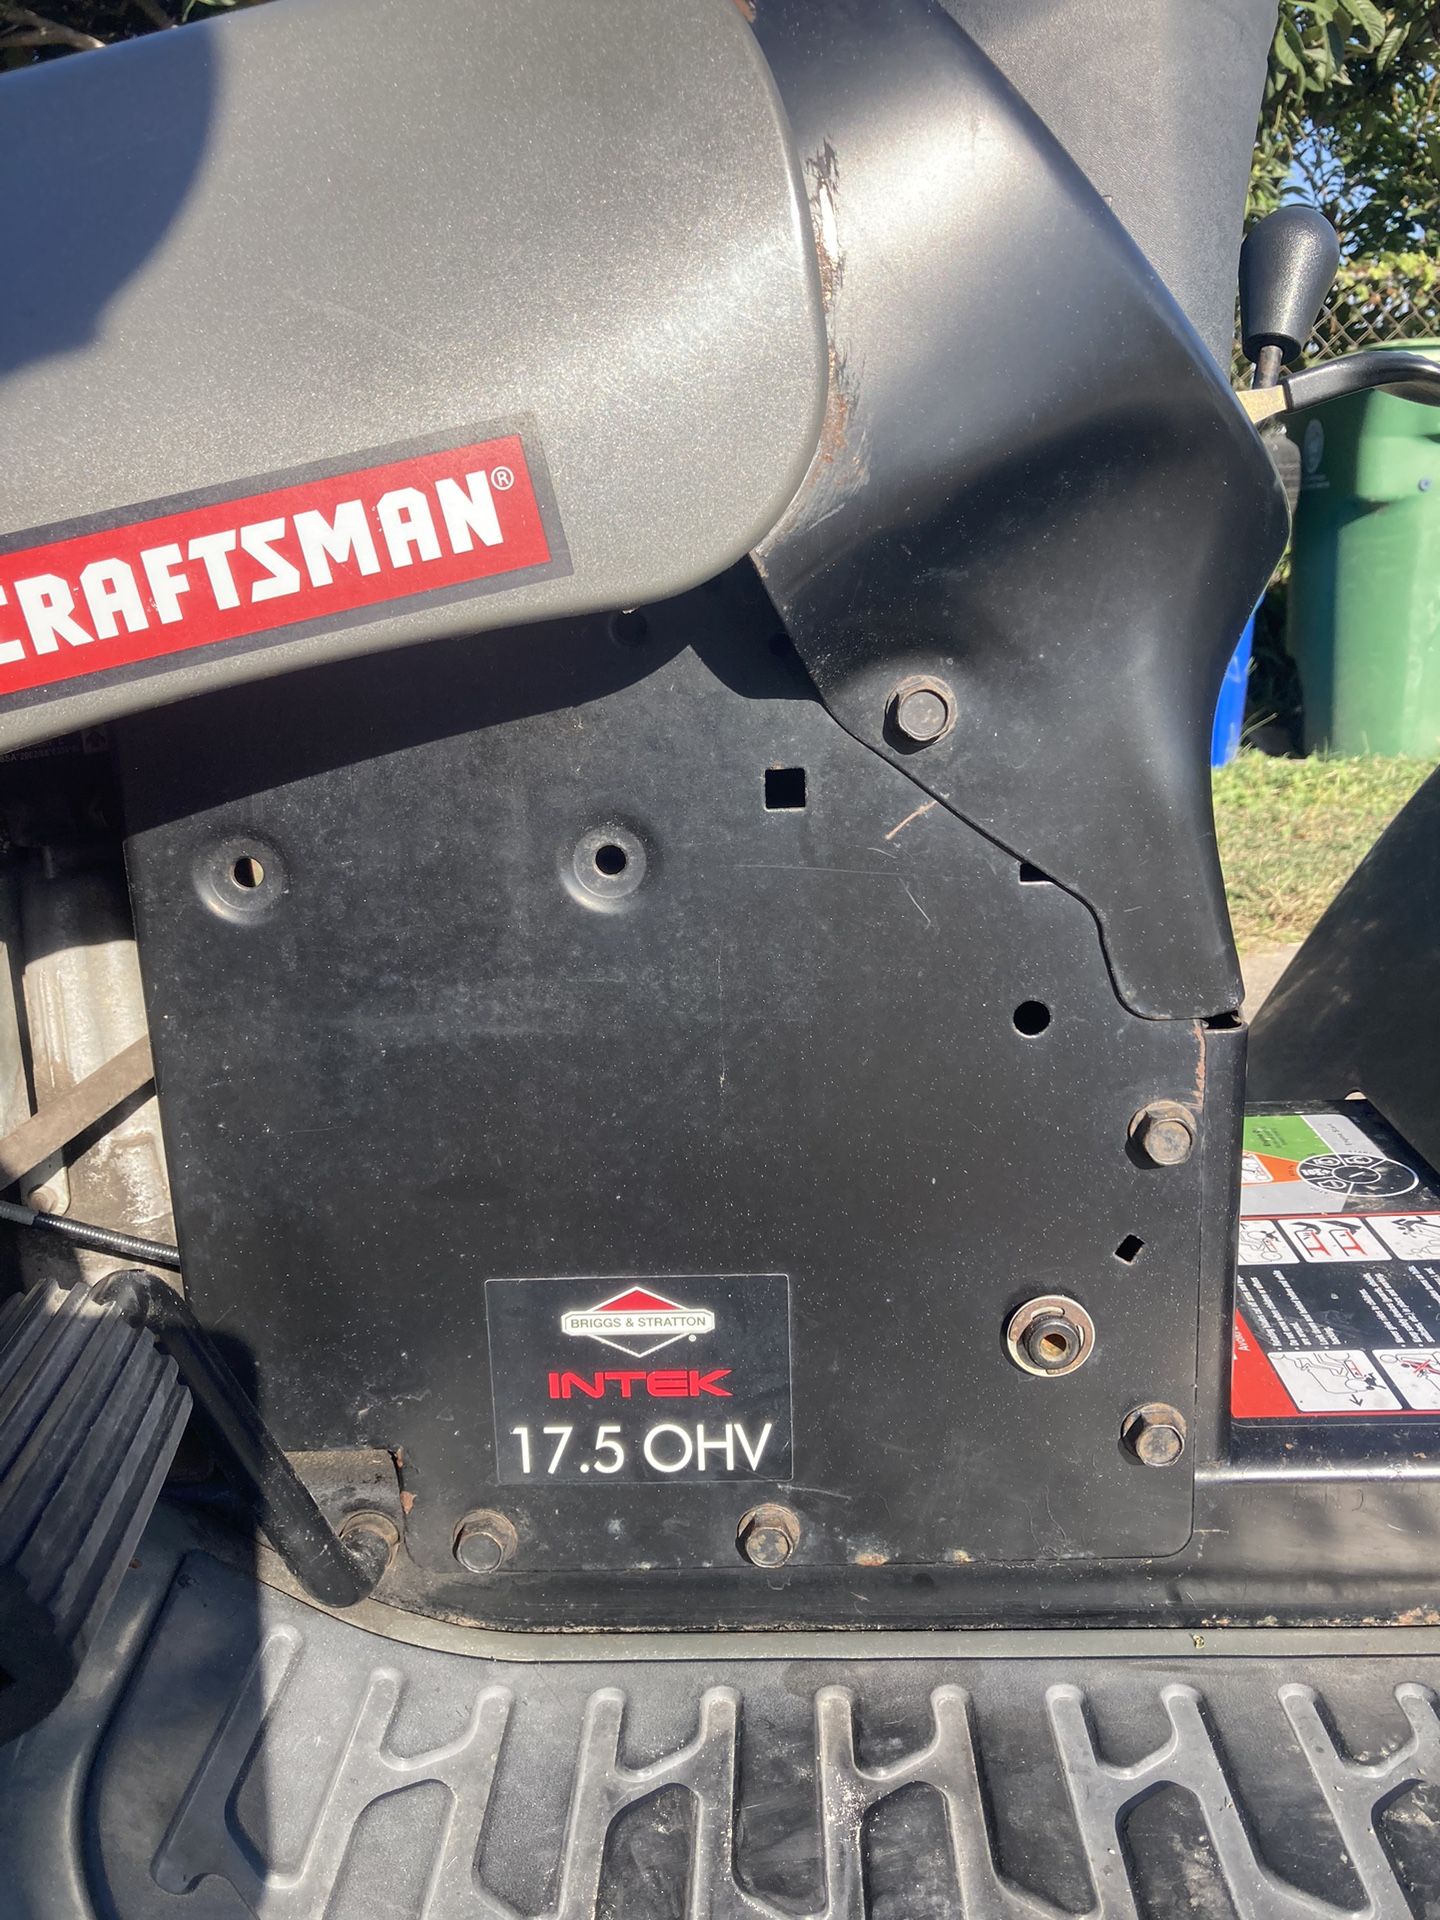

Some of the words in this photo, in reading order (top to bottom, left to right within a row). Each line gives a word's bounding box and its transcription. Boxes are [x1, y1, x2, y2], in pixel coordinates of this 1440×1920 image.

[570, 1318, 621, 1329] BRIGGS
[625, 1318, 634, 1328] &
[638, 1316, 706, 1327] STRATTON
[548, 1369, 734, 1399] INTEK
[510, 1425, 625, 1474] 17.5
[643, 1423, 772, 1474] OHV
